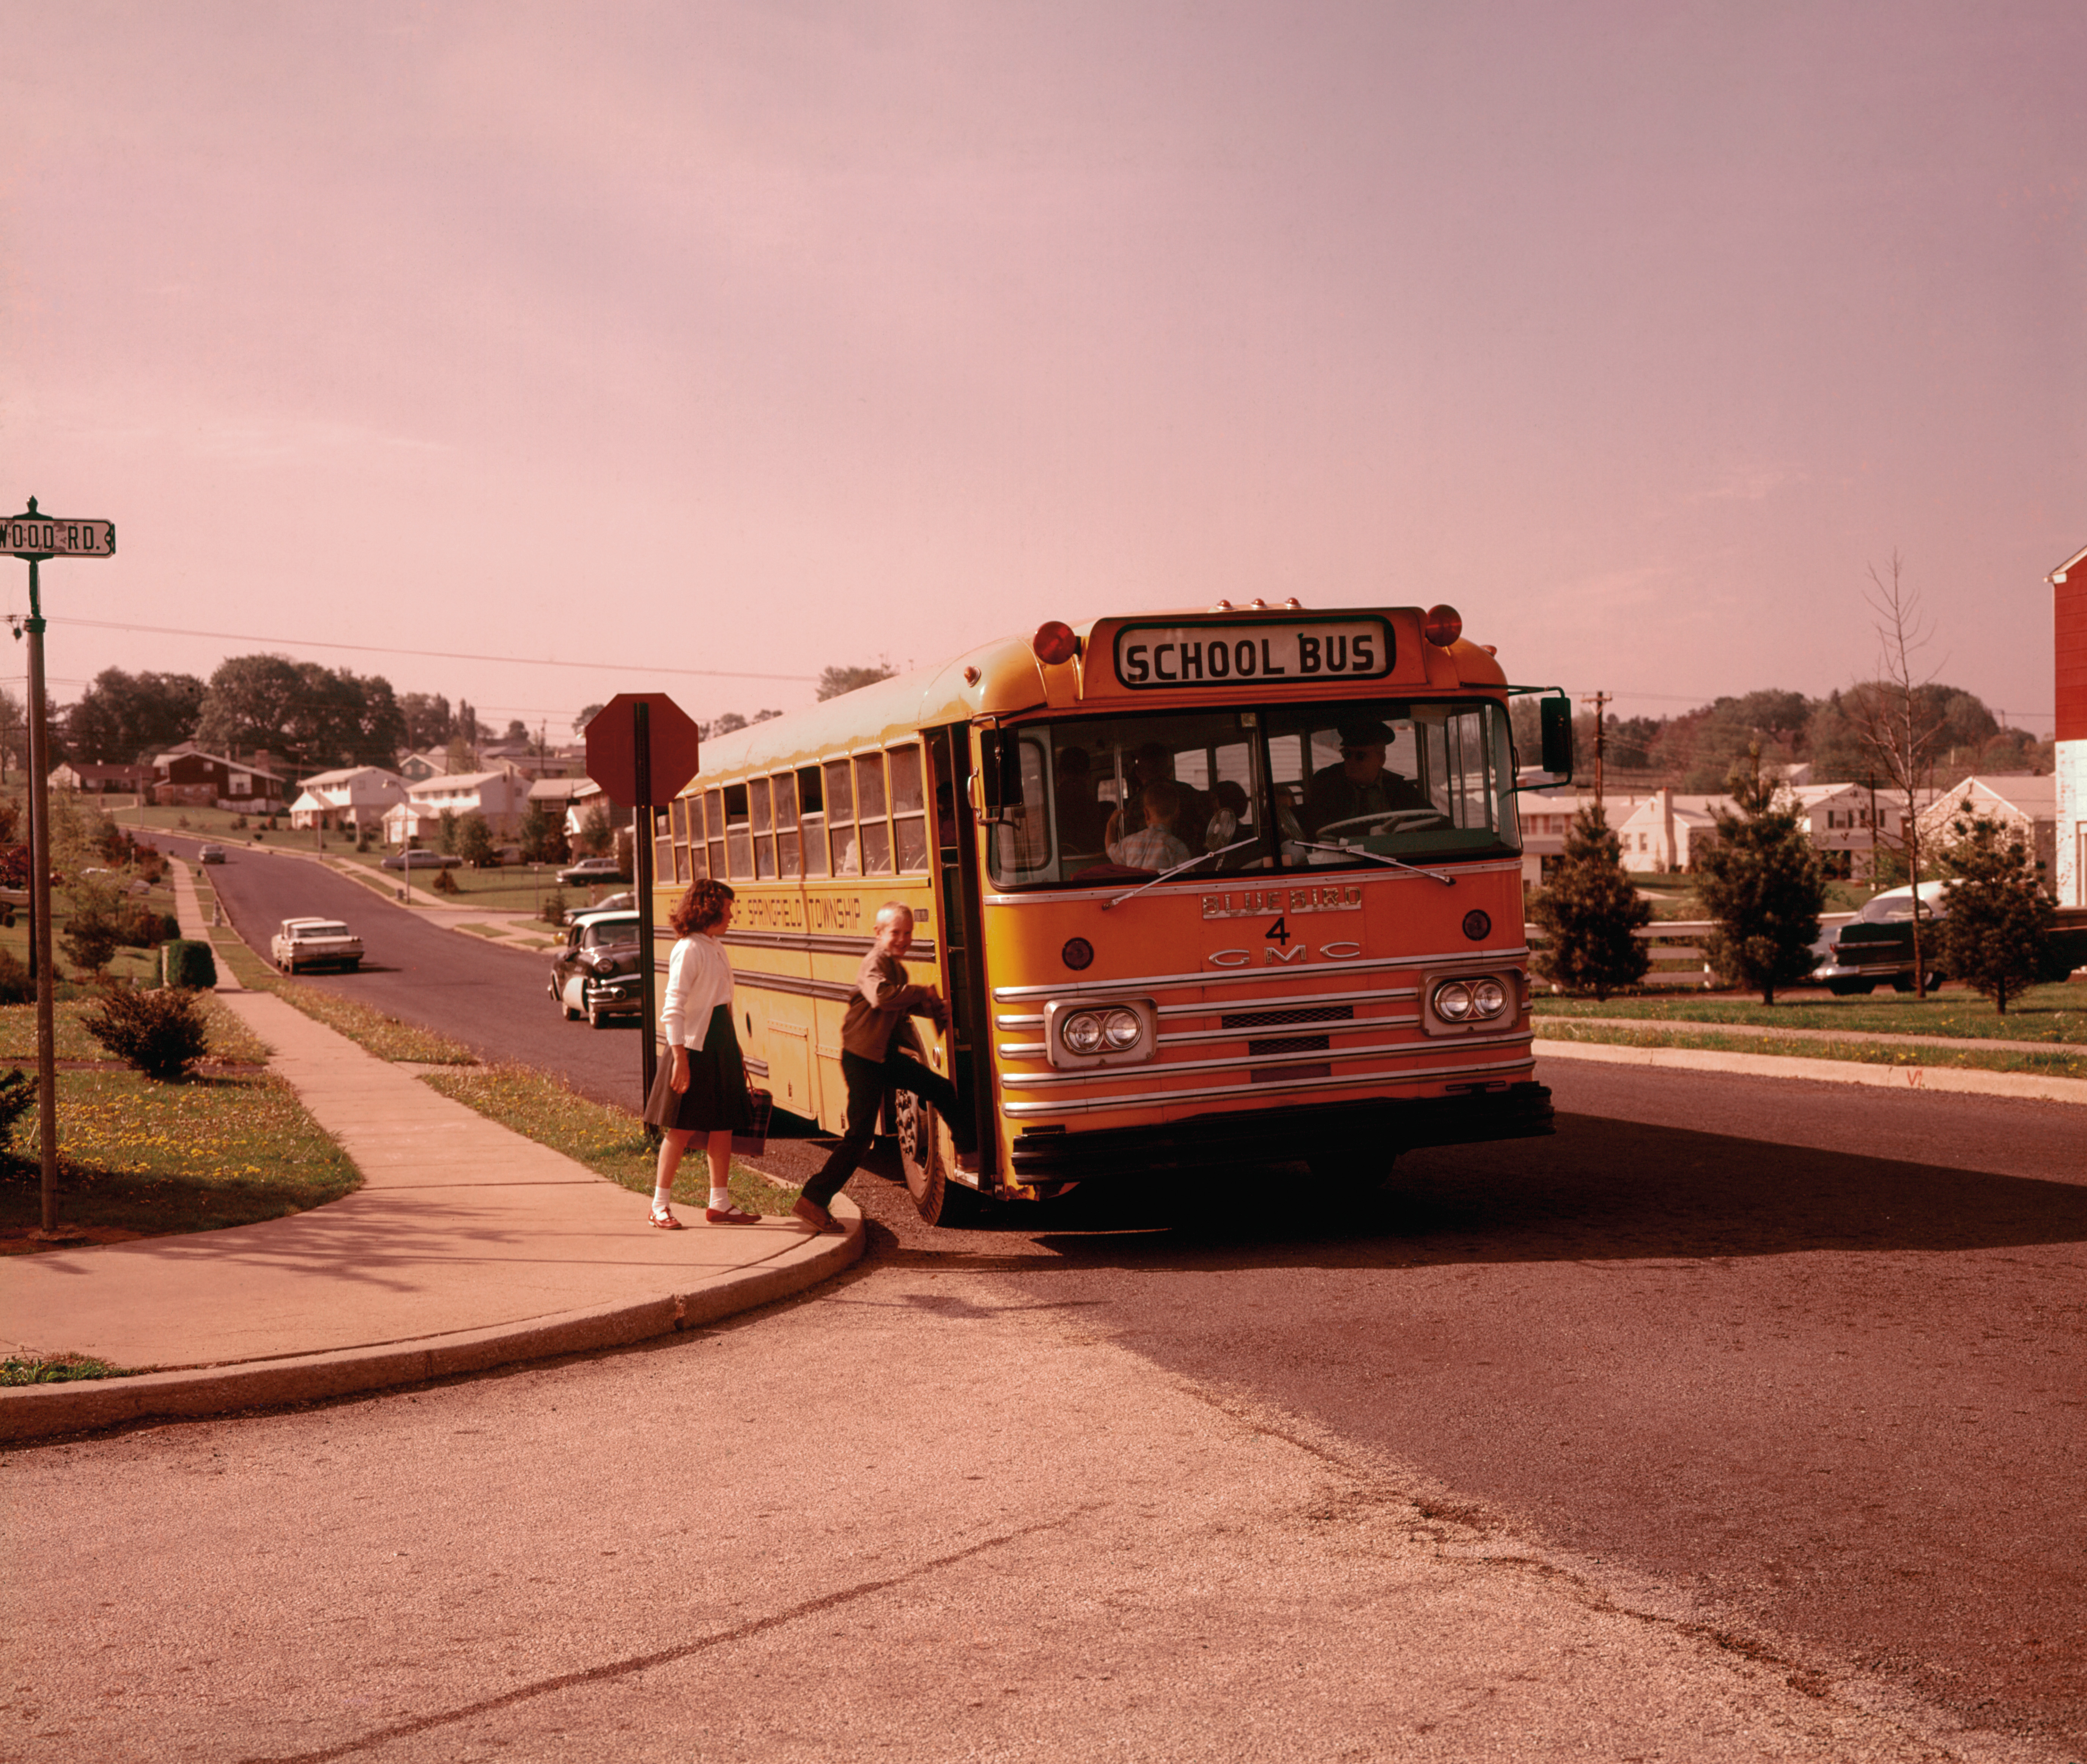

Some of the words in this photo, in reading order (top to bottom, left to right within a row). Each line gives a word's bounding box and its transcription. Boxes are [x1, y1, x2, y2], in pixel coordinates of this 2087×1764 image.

[0, 524, 54, 549] WOOD
[68, 526, 100, 549] RD.
[1126, 638, 1285, 682] SCHOOL
[1299, 635, 1374, 674] BUS
[748, 899, 802, 927] SPRINGFIELD
[809, 898, 861, 929] TOWNSHIP
[1202, 892, 1283, 915] BLUE
[1290, 887, 1361, 909] BIRD
[1265, 917, 1291, 945] 4
[1209, 941, 1360, 966] GMC
